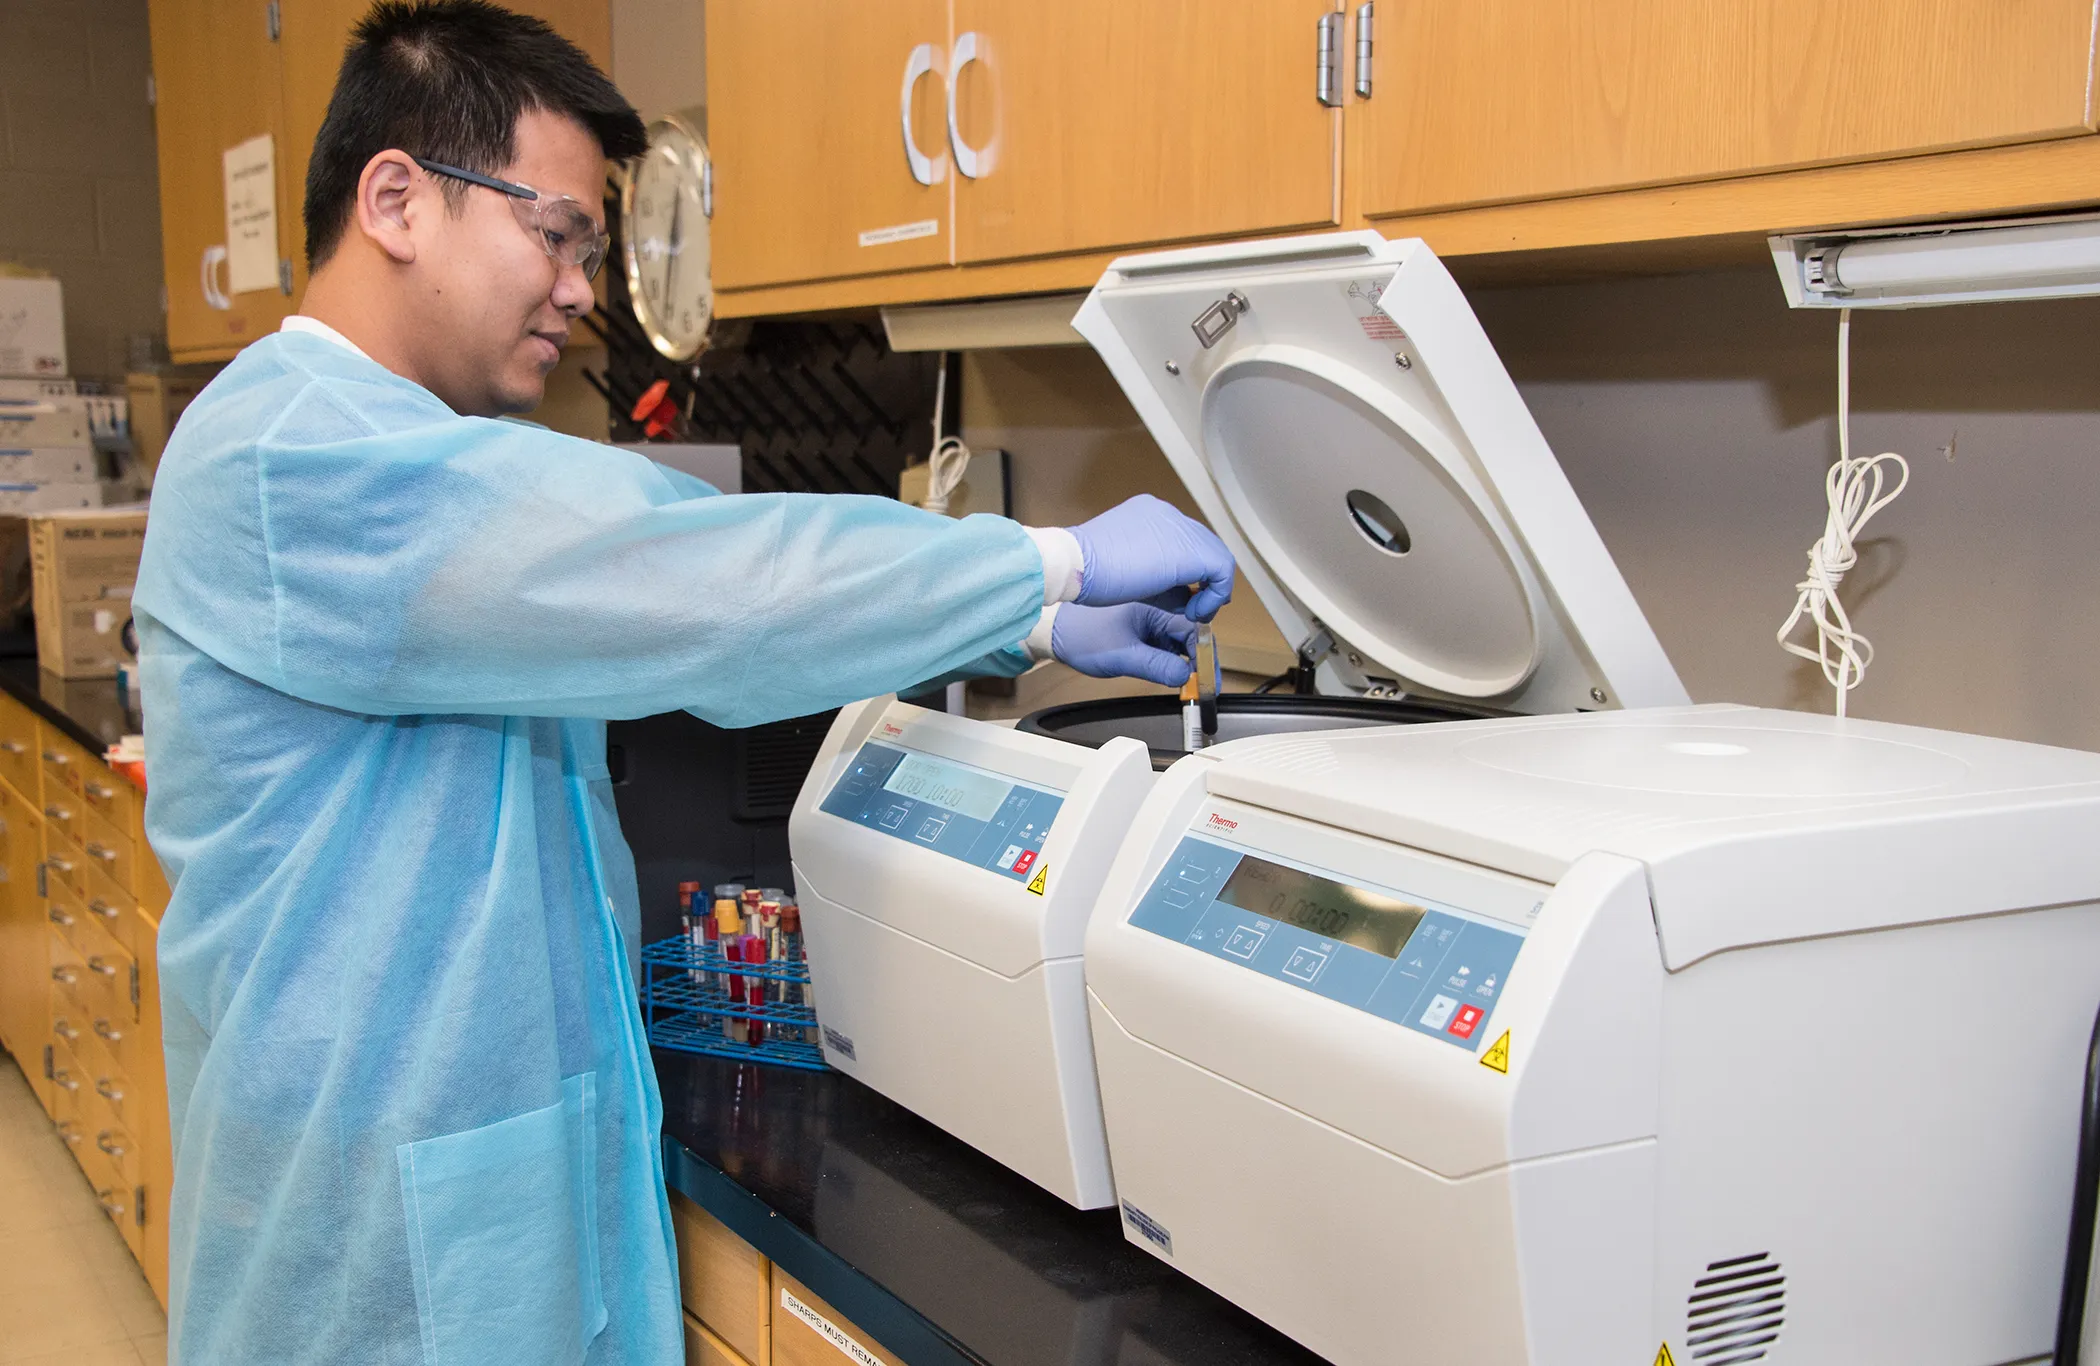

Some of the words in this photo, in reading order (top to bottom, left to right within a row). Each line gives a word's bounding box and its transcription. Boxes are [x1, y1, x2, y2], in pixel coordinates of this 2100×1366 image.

[884, 723, 902, 735] Thermo
[896, 773, 926, 795] 1700
[925, 783, 964, 807] 10:00
[1209, 813, 1238, 829] Thermo
[1206, 823, 1233, 834] SCIENTIFIC
[1016, 862, 1028, 870] STOP
[1288, 899, 1349, 935] 00:00
[1320, 942, 1333, 952] TIME
[1476, 985, 1494, 996] OPEN
[1454, 1021, 1471, 1032] STOP
[788, 1297, 822, 1328] SHARPS
[824, 1323, 849, 1348] MUST
[852, 1344, 881, 1366] REMA
